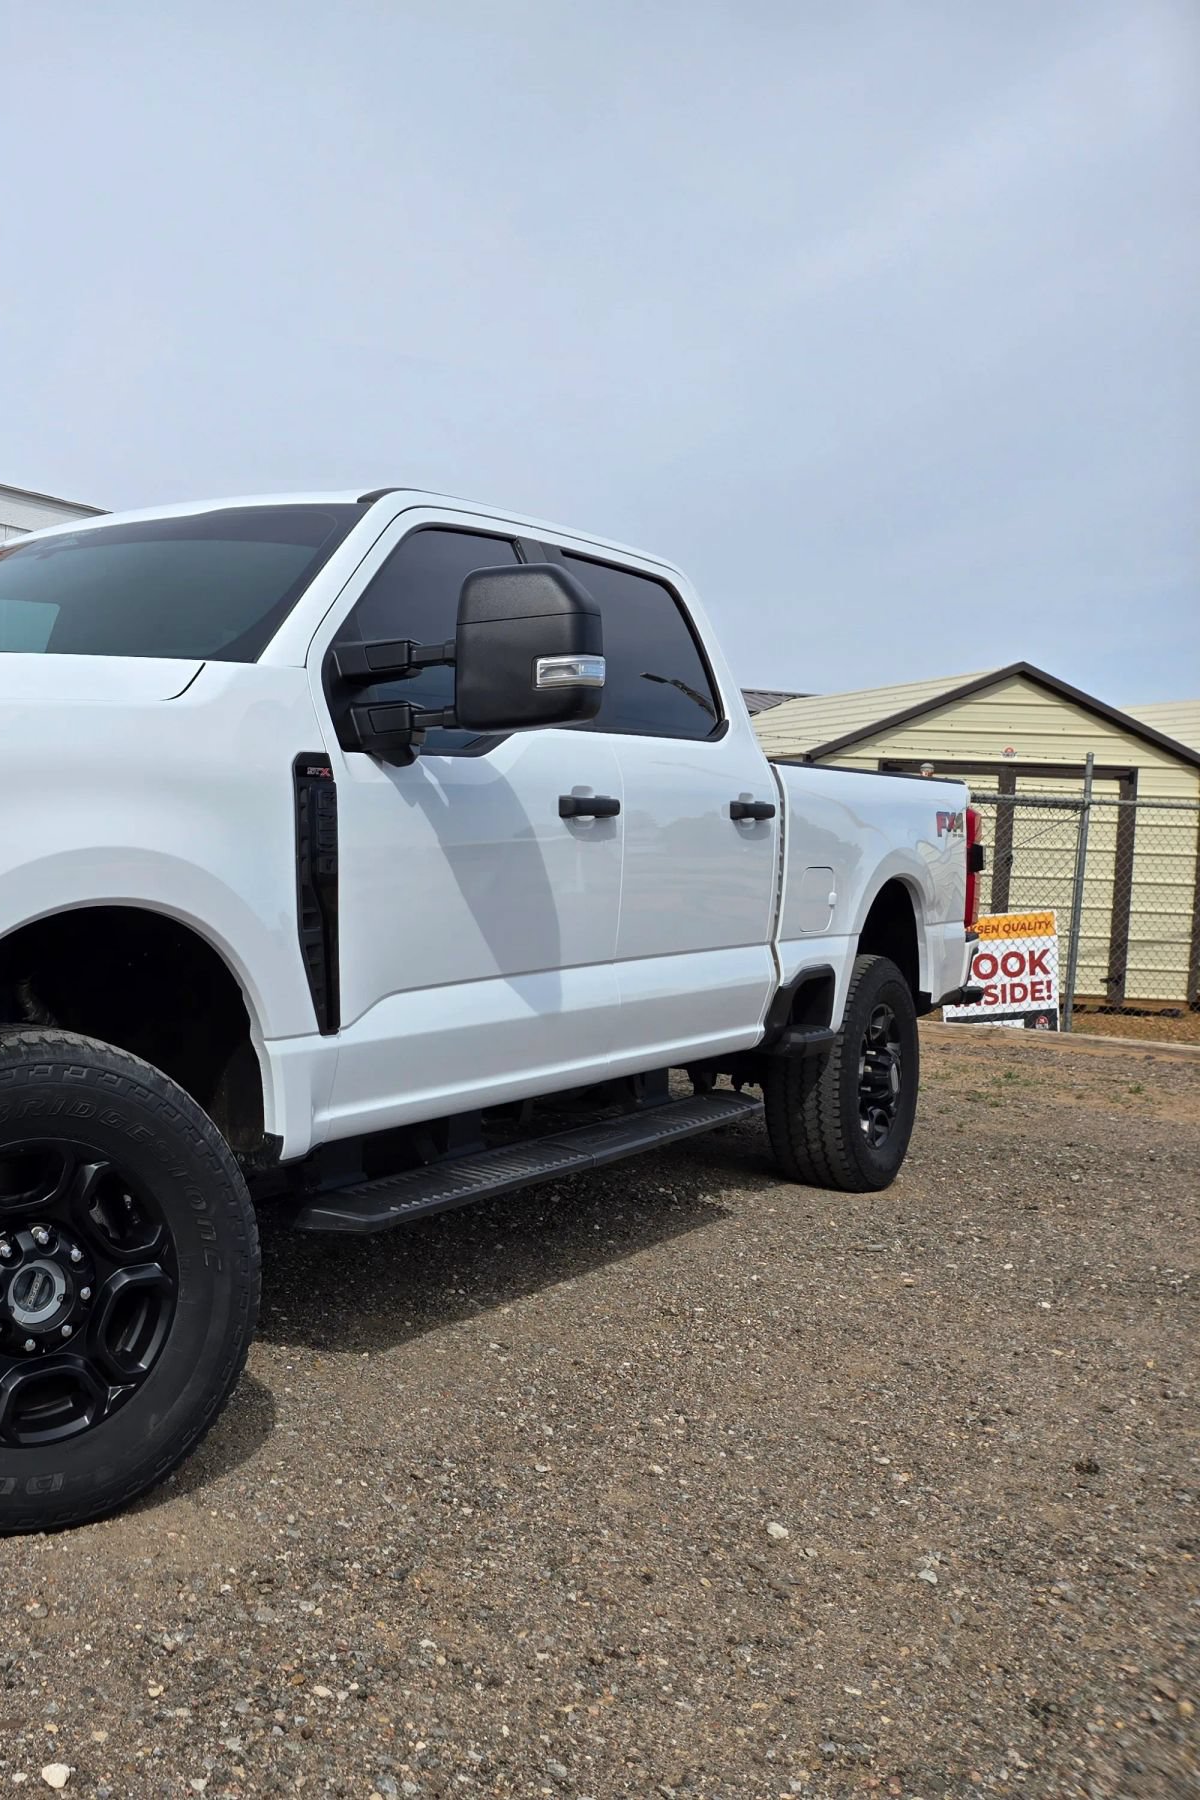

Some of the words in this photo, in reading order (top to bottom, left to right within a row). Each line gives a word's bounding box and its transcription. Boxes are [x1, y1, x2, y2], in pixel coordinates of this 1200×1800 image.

[936, 811, 964, 837] FX4
[1002, 920, 1051, 934] QUALITY
[968, 948, 1052, 980] OOK
[954, 980, 1053, 1008] SIDE!
